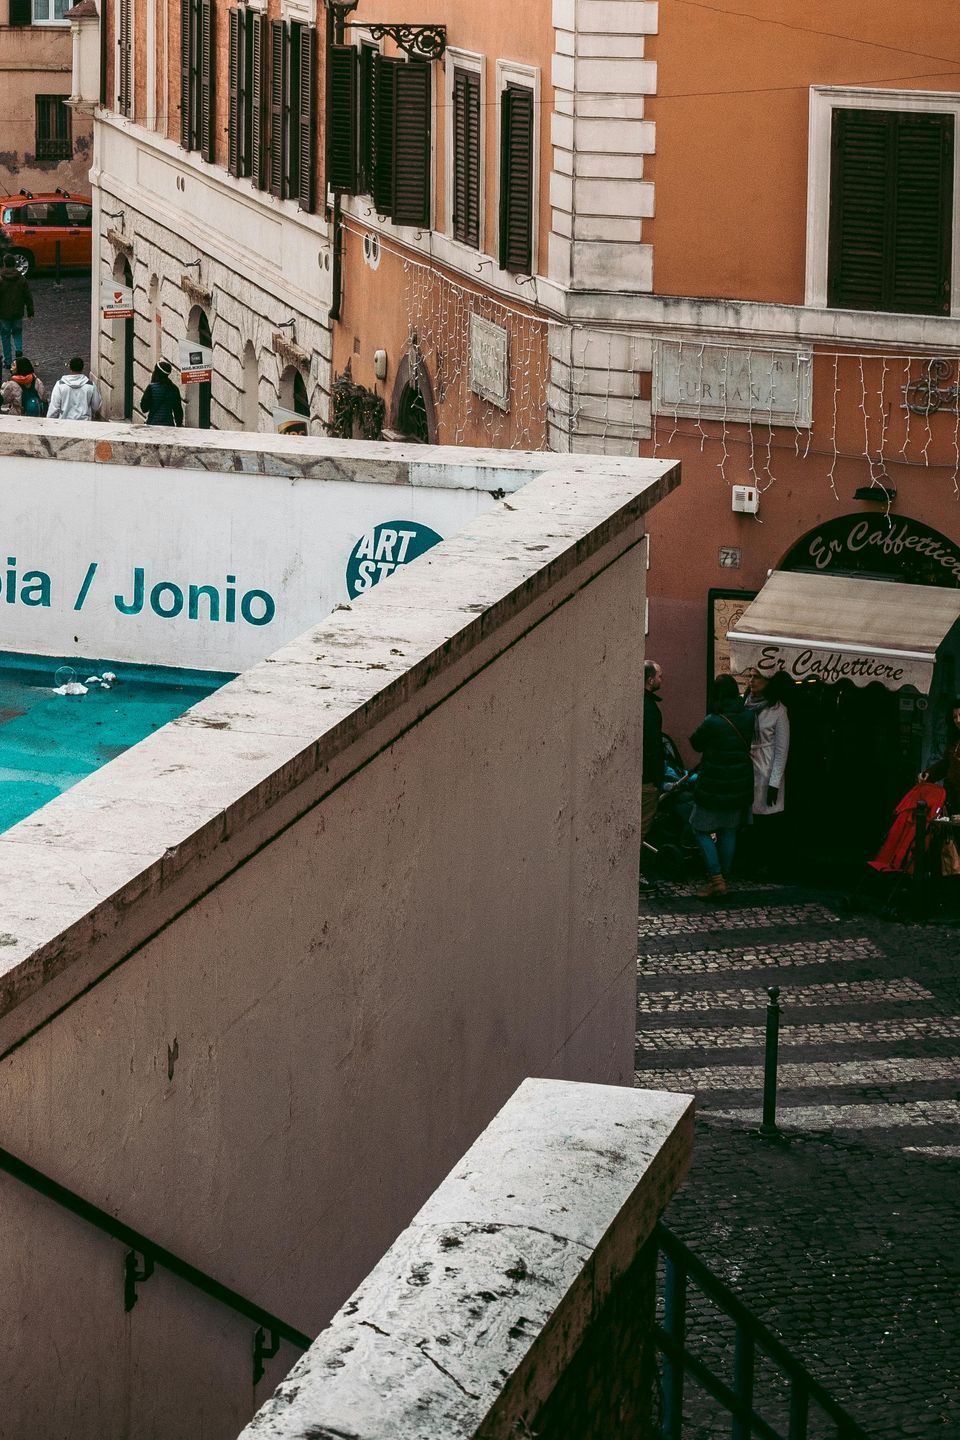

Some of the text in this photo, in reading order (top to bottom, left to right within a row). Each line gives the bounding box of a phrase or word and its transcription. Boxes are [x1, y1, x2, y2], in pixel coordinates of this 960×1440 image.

[685, 381, 777, 404] URBANA
[355, 528, 417, 563] ART
[720, 550, 738, 568] 72
[808, 521, 960, 582] Er Caffettier
[354, 560, 407, 593] ST
[74, 563, 97, 611] /
[114, 567, 276, 627] Jonio
[757, 647, 786, 670] Er
[791, 649, 904, 682] Caffettiere
